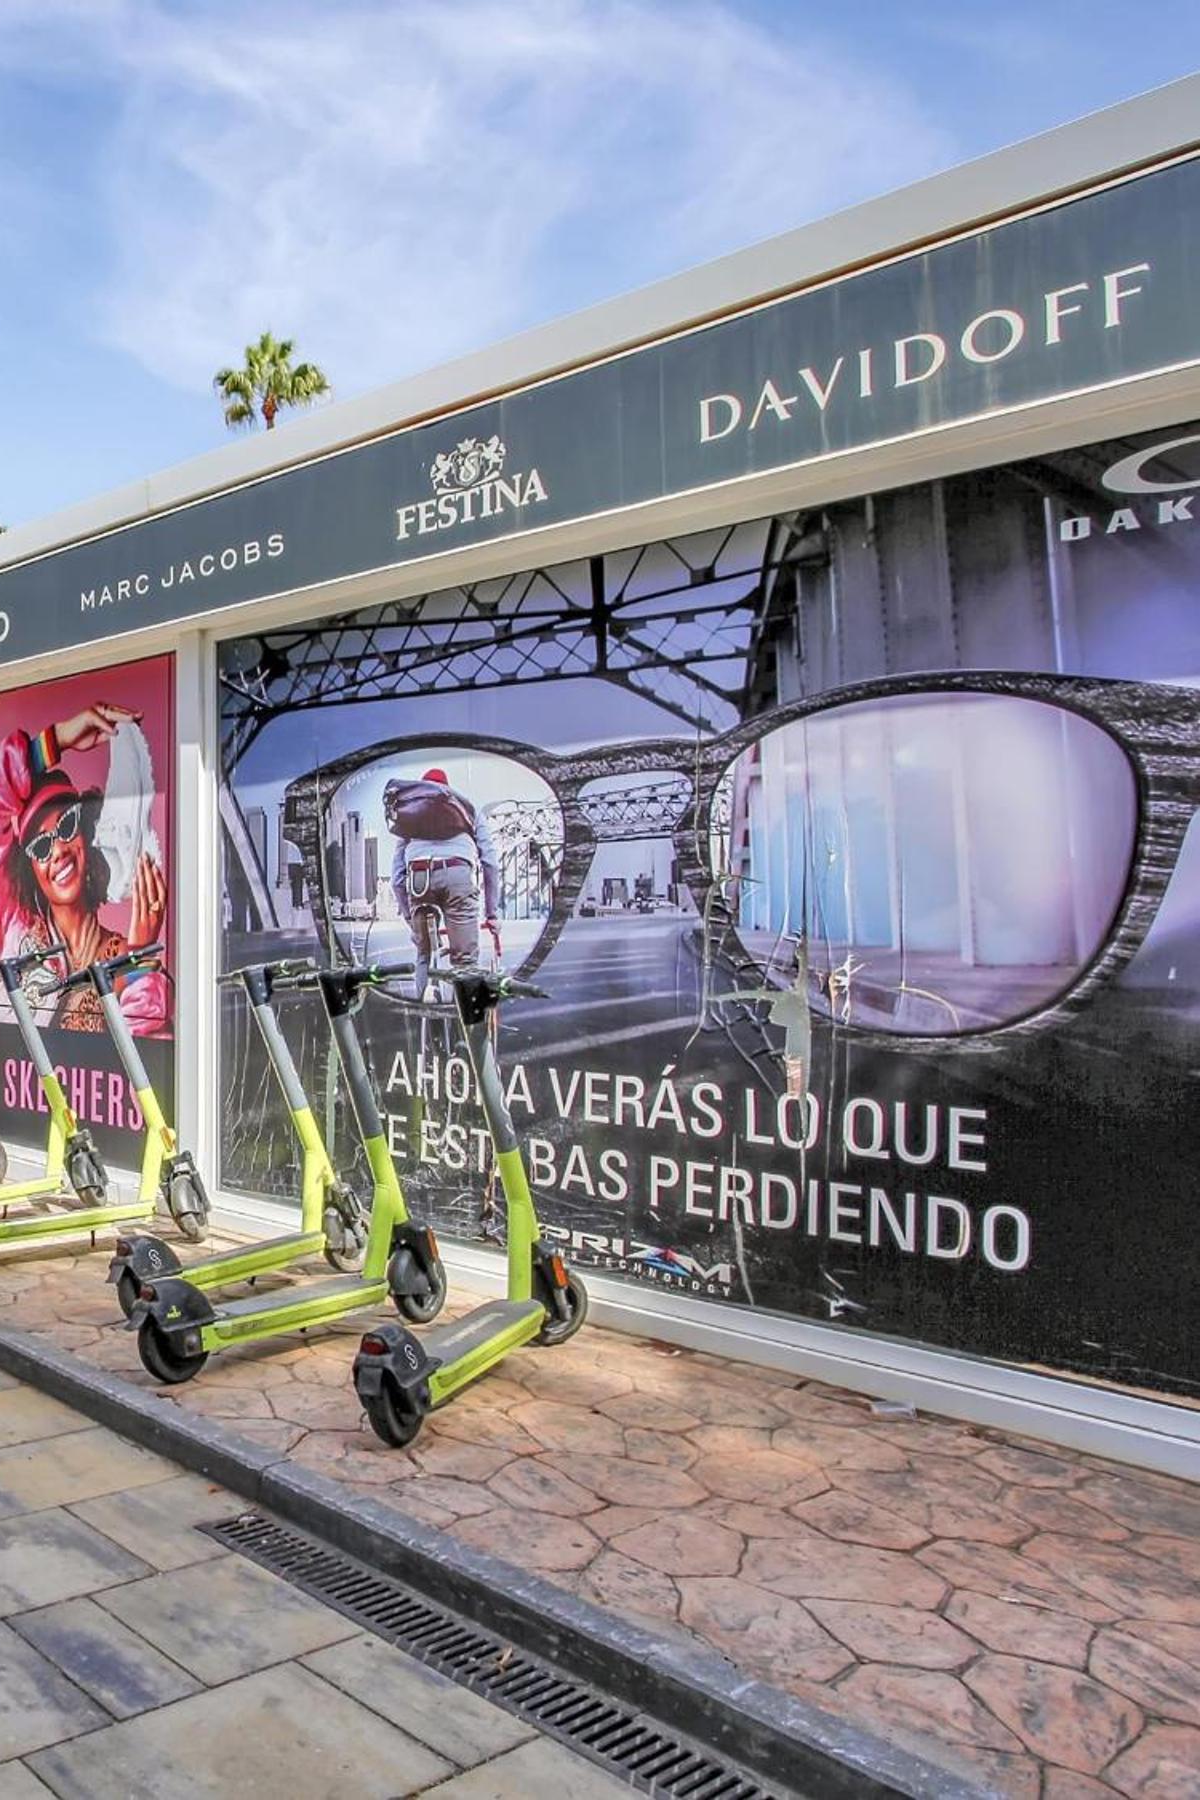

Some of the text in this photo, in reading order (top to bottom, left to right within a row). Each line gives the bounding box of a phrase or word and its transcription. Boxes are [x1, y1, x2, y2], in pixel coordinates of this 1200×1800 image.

[699, 262, 1150, 445] DAVIDOFF
[396, 467, 548, 541] FESTINA
[1059, 496, 1196, 543] OAK
[80, 533, 285, 612] MARC JACOBS
[385, 1050, 987, 1172] AHOA VERÁS LO QUE
[419, 1119, 629, 1201] ESTBAS
[649, 1155, 1031, 1272] PERDIENDO
[592, 1255, 731, 1298] TECHNOLOGY
